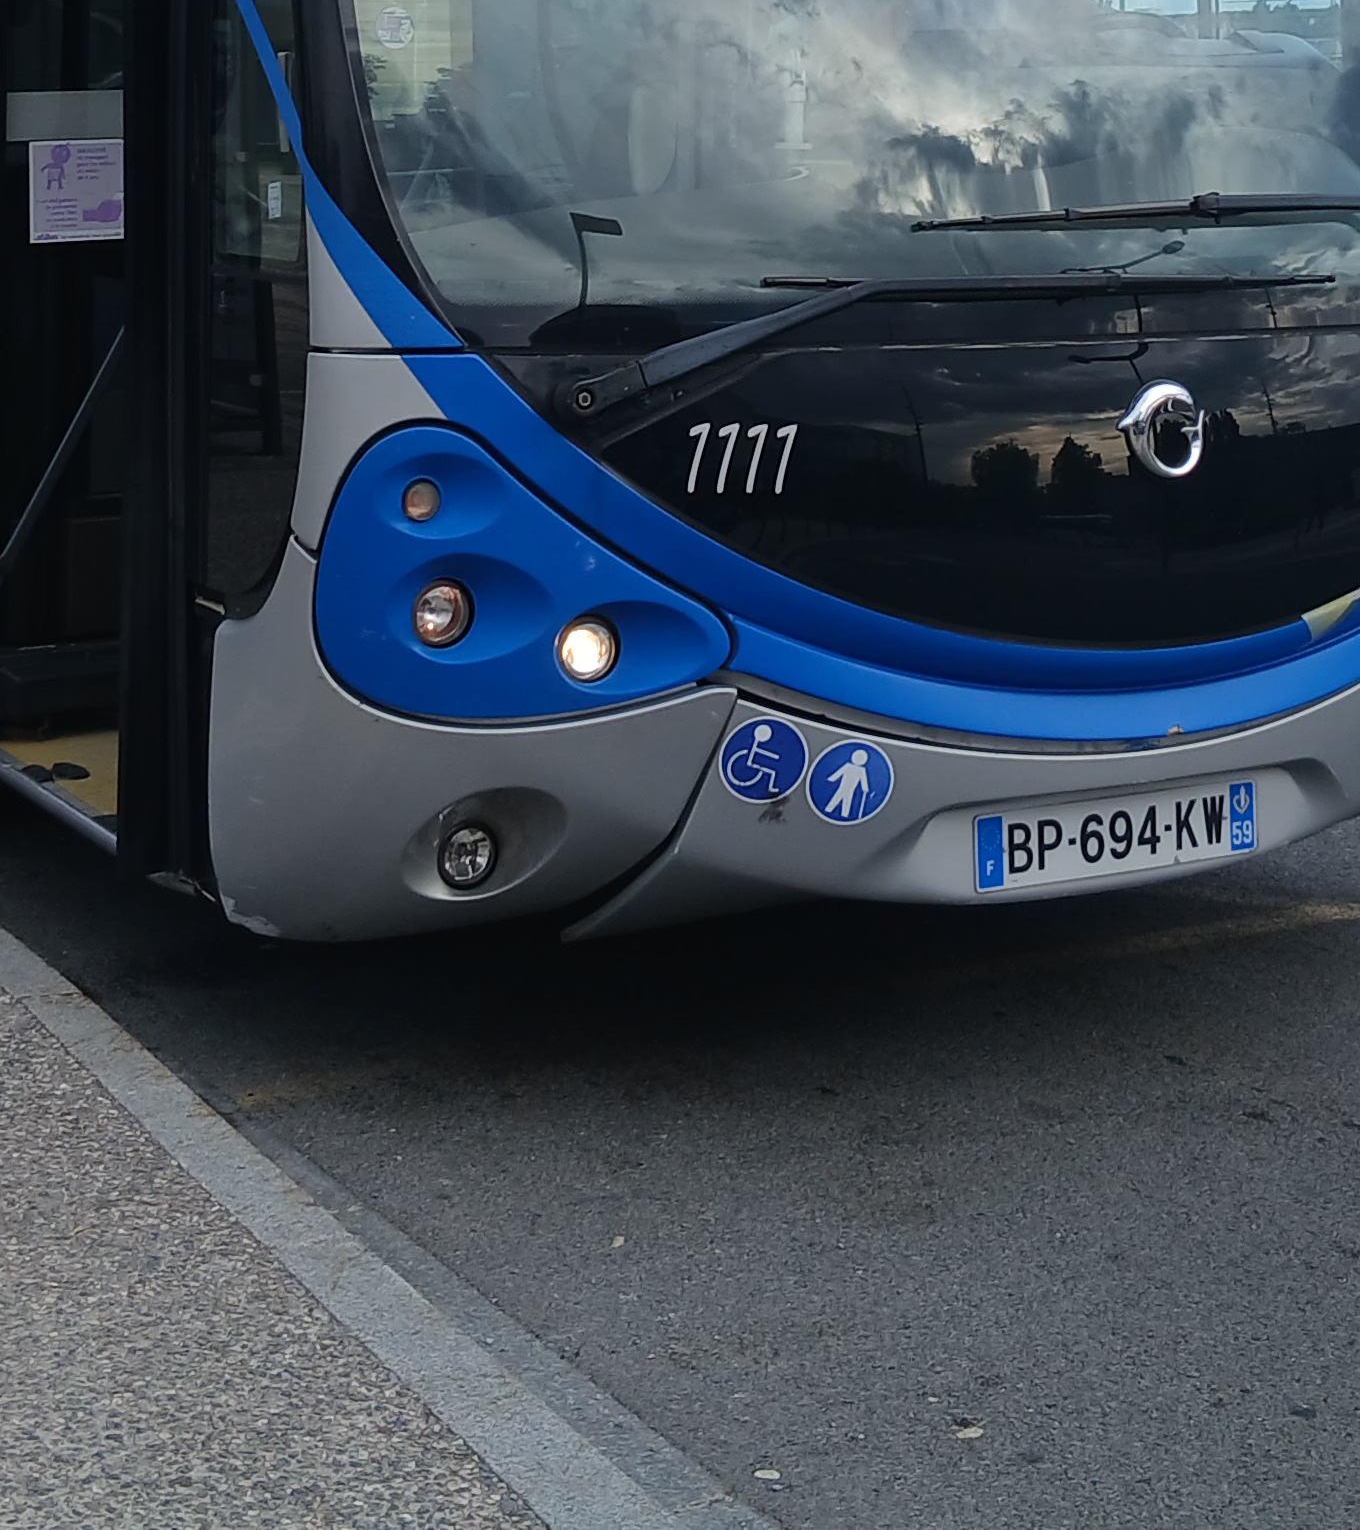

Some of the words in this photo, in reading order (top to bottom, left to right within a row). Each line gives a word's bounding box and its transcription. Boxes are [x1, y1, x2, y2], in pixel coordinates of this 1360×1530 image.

[687, 422, 798, 494] 1111
[986, 860, 995, 876] F
[1007, 795, 1225, 874] BP-694-KW
[1232, 820, 1253, 845] 59
